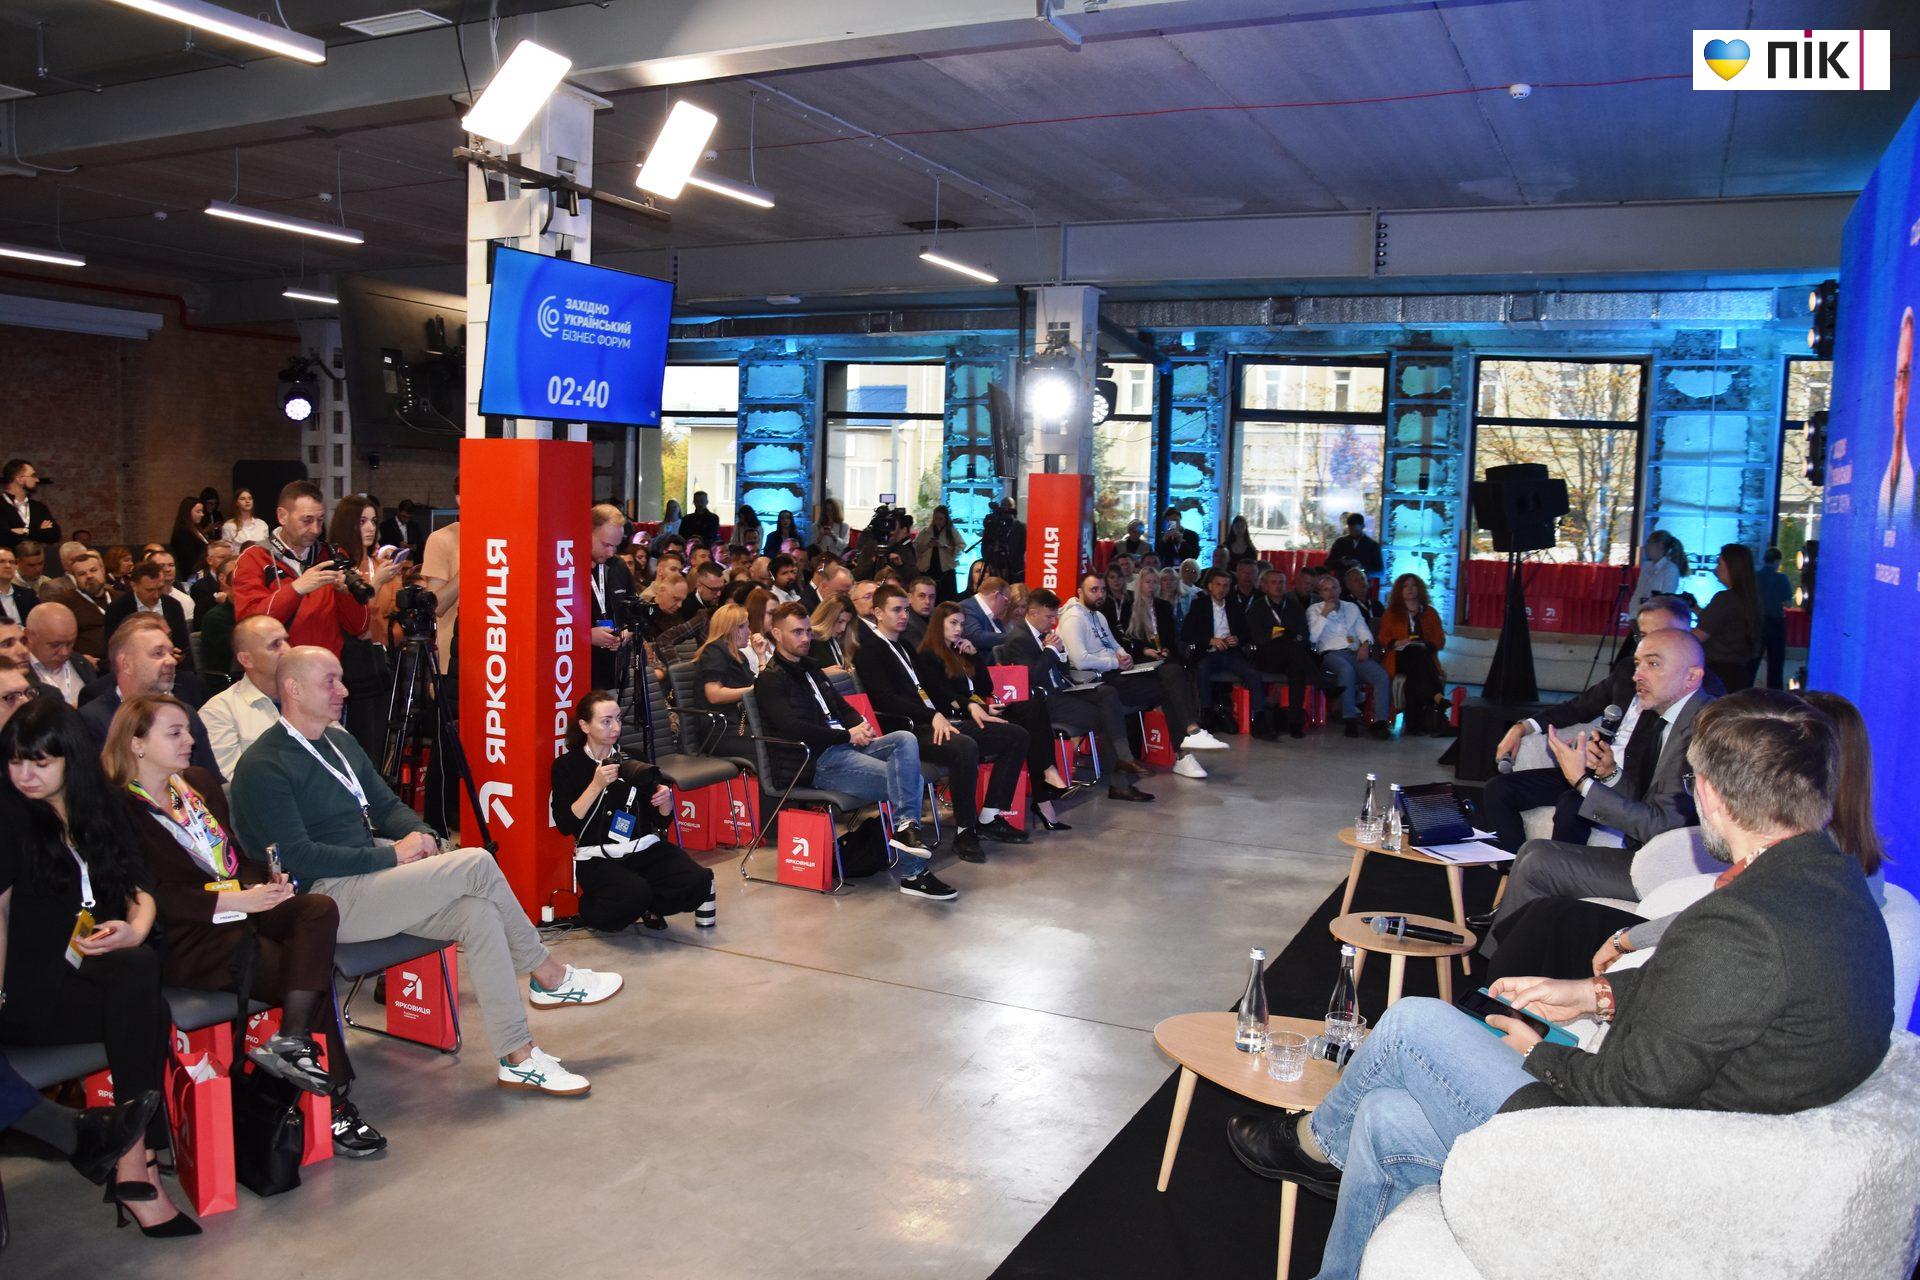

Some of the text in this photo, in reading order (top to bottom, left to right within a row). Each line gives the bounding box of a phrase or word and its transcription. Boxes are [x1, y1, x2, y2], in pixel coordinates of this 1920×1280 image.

[565, 298, 609, 315] ЗАХІДНО
[563, 313, 631, 334] УКРАЇНСЬКИЙ
[561, 330, 631, 350] БІЗНЕС ФОРУМ
[547, 375, 610, 409] 02:40
[1043, 528, 1060, 594] ВИЦЯ
[486, 538, 510, 765] ЯРКОВИЦЯ
[677, 820, 700, 829] РКОВИЦЯ
[724, 819, 751, 828] ЯРКВИЦЯ
[394, 1000, 432, 1015] ЯРКОВИЦЯ
